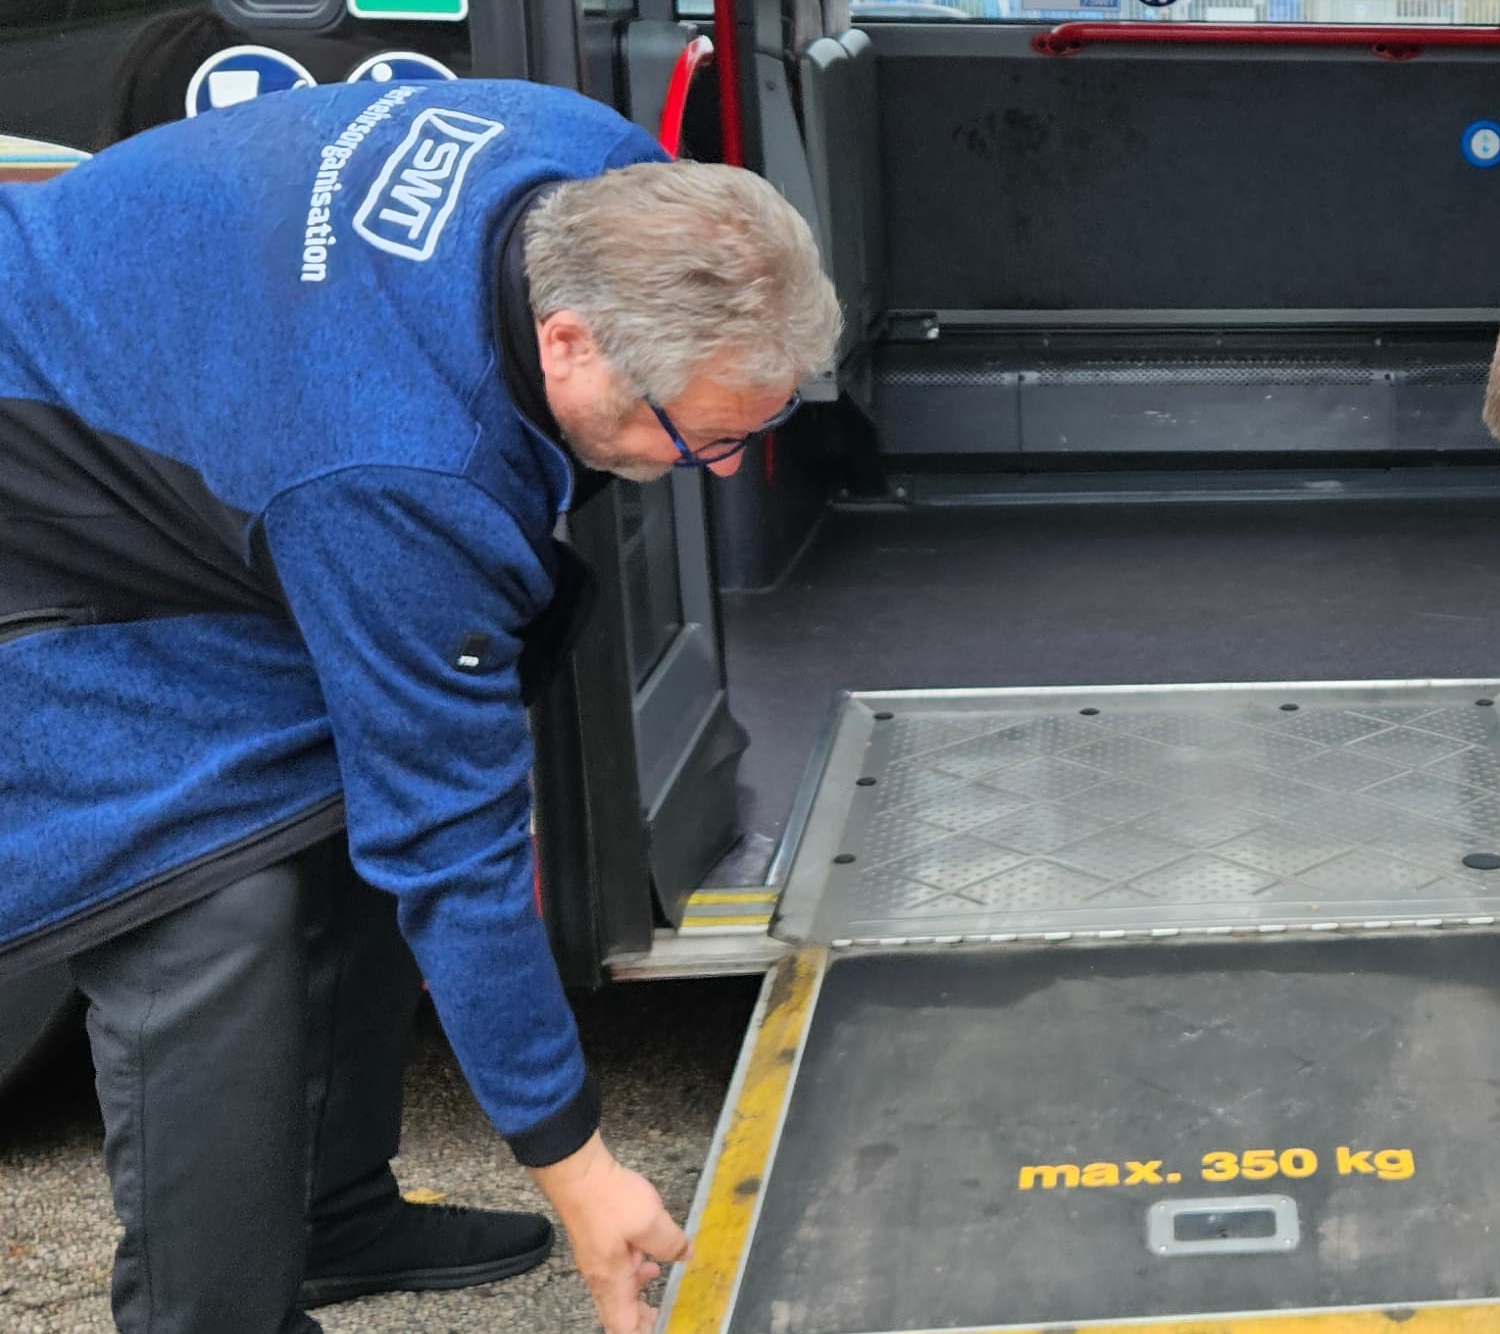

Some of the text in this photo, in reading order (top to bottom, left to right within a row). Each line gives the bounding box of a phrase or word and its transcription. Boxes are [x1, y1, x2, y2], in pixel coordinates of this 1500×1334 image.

[300, 85, 428, 282] Verkehrsorganisation
[378, 138, 461, 240] SWT
[1018, 1145, 1416, 1190] max. 350 kg
